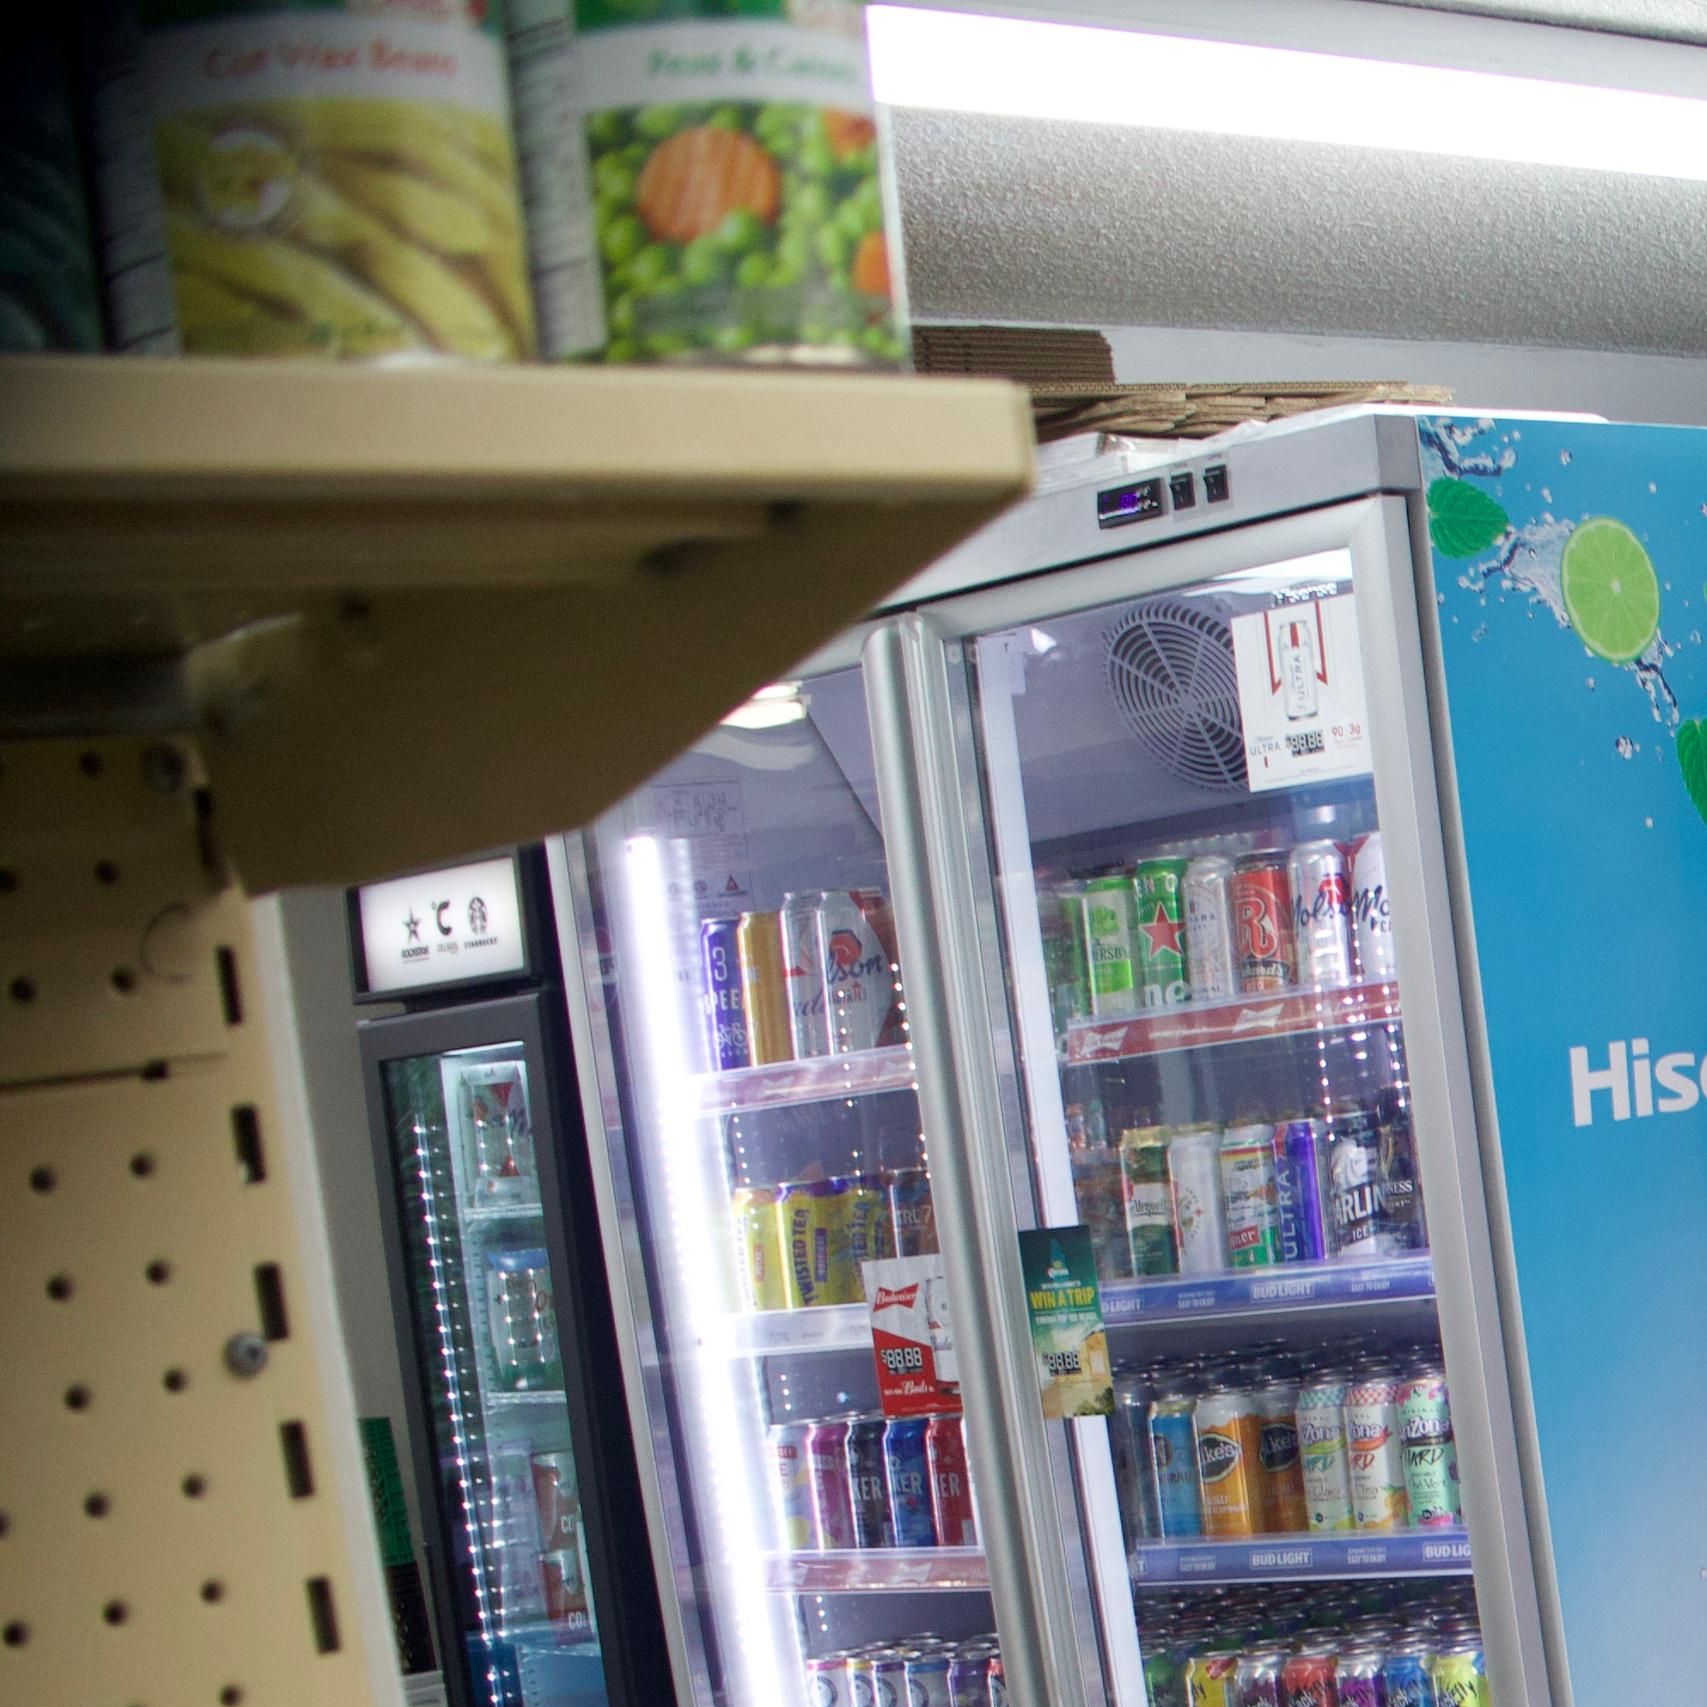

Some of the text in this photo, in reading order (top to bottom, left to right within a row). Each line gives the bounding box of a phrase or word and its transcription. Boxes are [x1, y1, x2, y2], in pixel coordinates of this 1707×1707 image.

[1331, 726, 1344, 738] 90
[1249, 741, 1280, 756] ULTRA
[1279, 1168, 1300, 1260] ULTRA
[1030, 1287, 1095, 1309] WIN A TRIP
[1252, 1282, 1313, 1300] BUD LIGHT
[1252, 1549, 1310, 1567] BUD LIGHT
[1425, 1544, 1449, 1559] BUD
